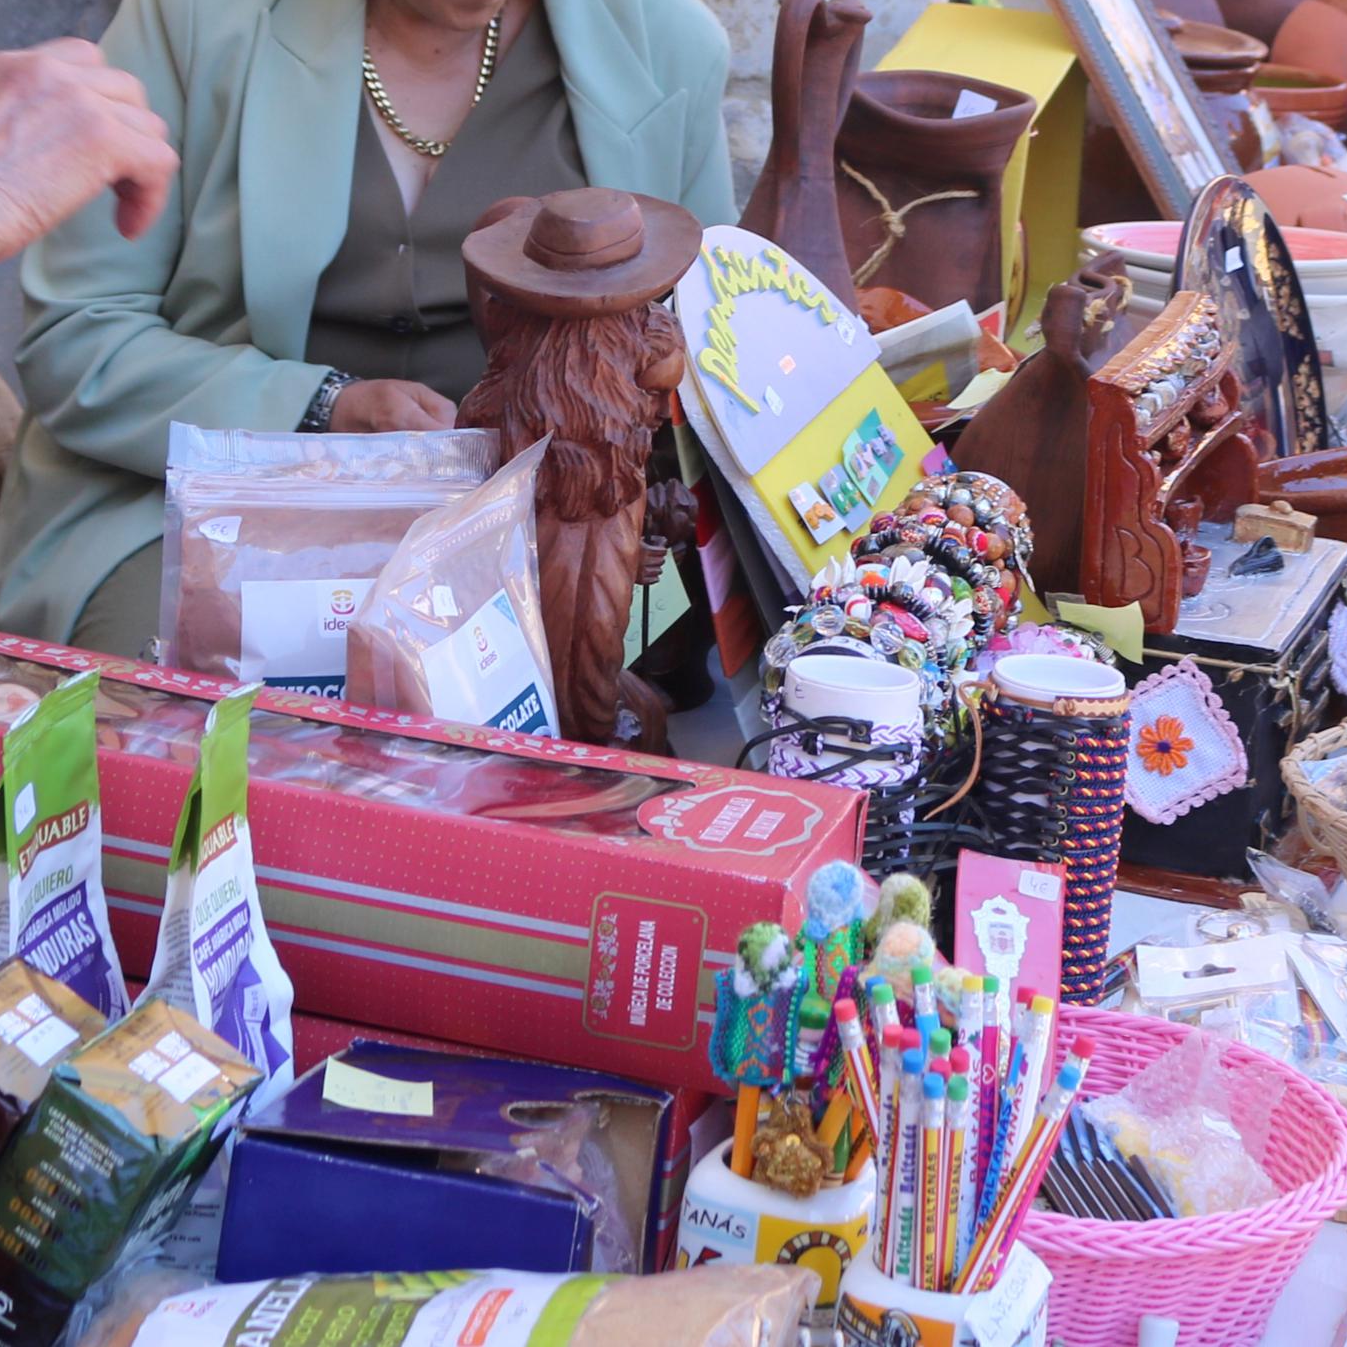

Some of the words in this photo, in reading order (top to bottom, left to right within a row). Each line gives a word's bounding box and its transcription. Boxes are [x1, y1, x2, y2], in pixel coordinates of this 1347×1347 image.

[634, 920, 656, 975] PORCELANA
[633, 975, 650, 990] DE
[627, 990, 649, 1027] MUÑECA
[655, 996, 672, 1011] DE
[31, 1196, 57, 1220] AROMA
